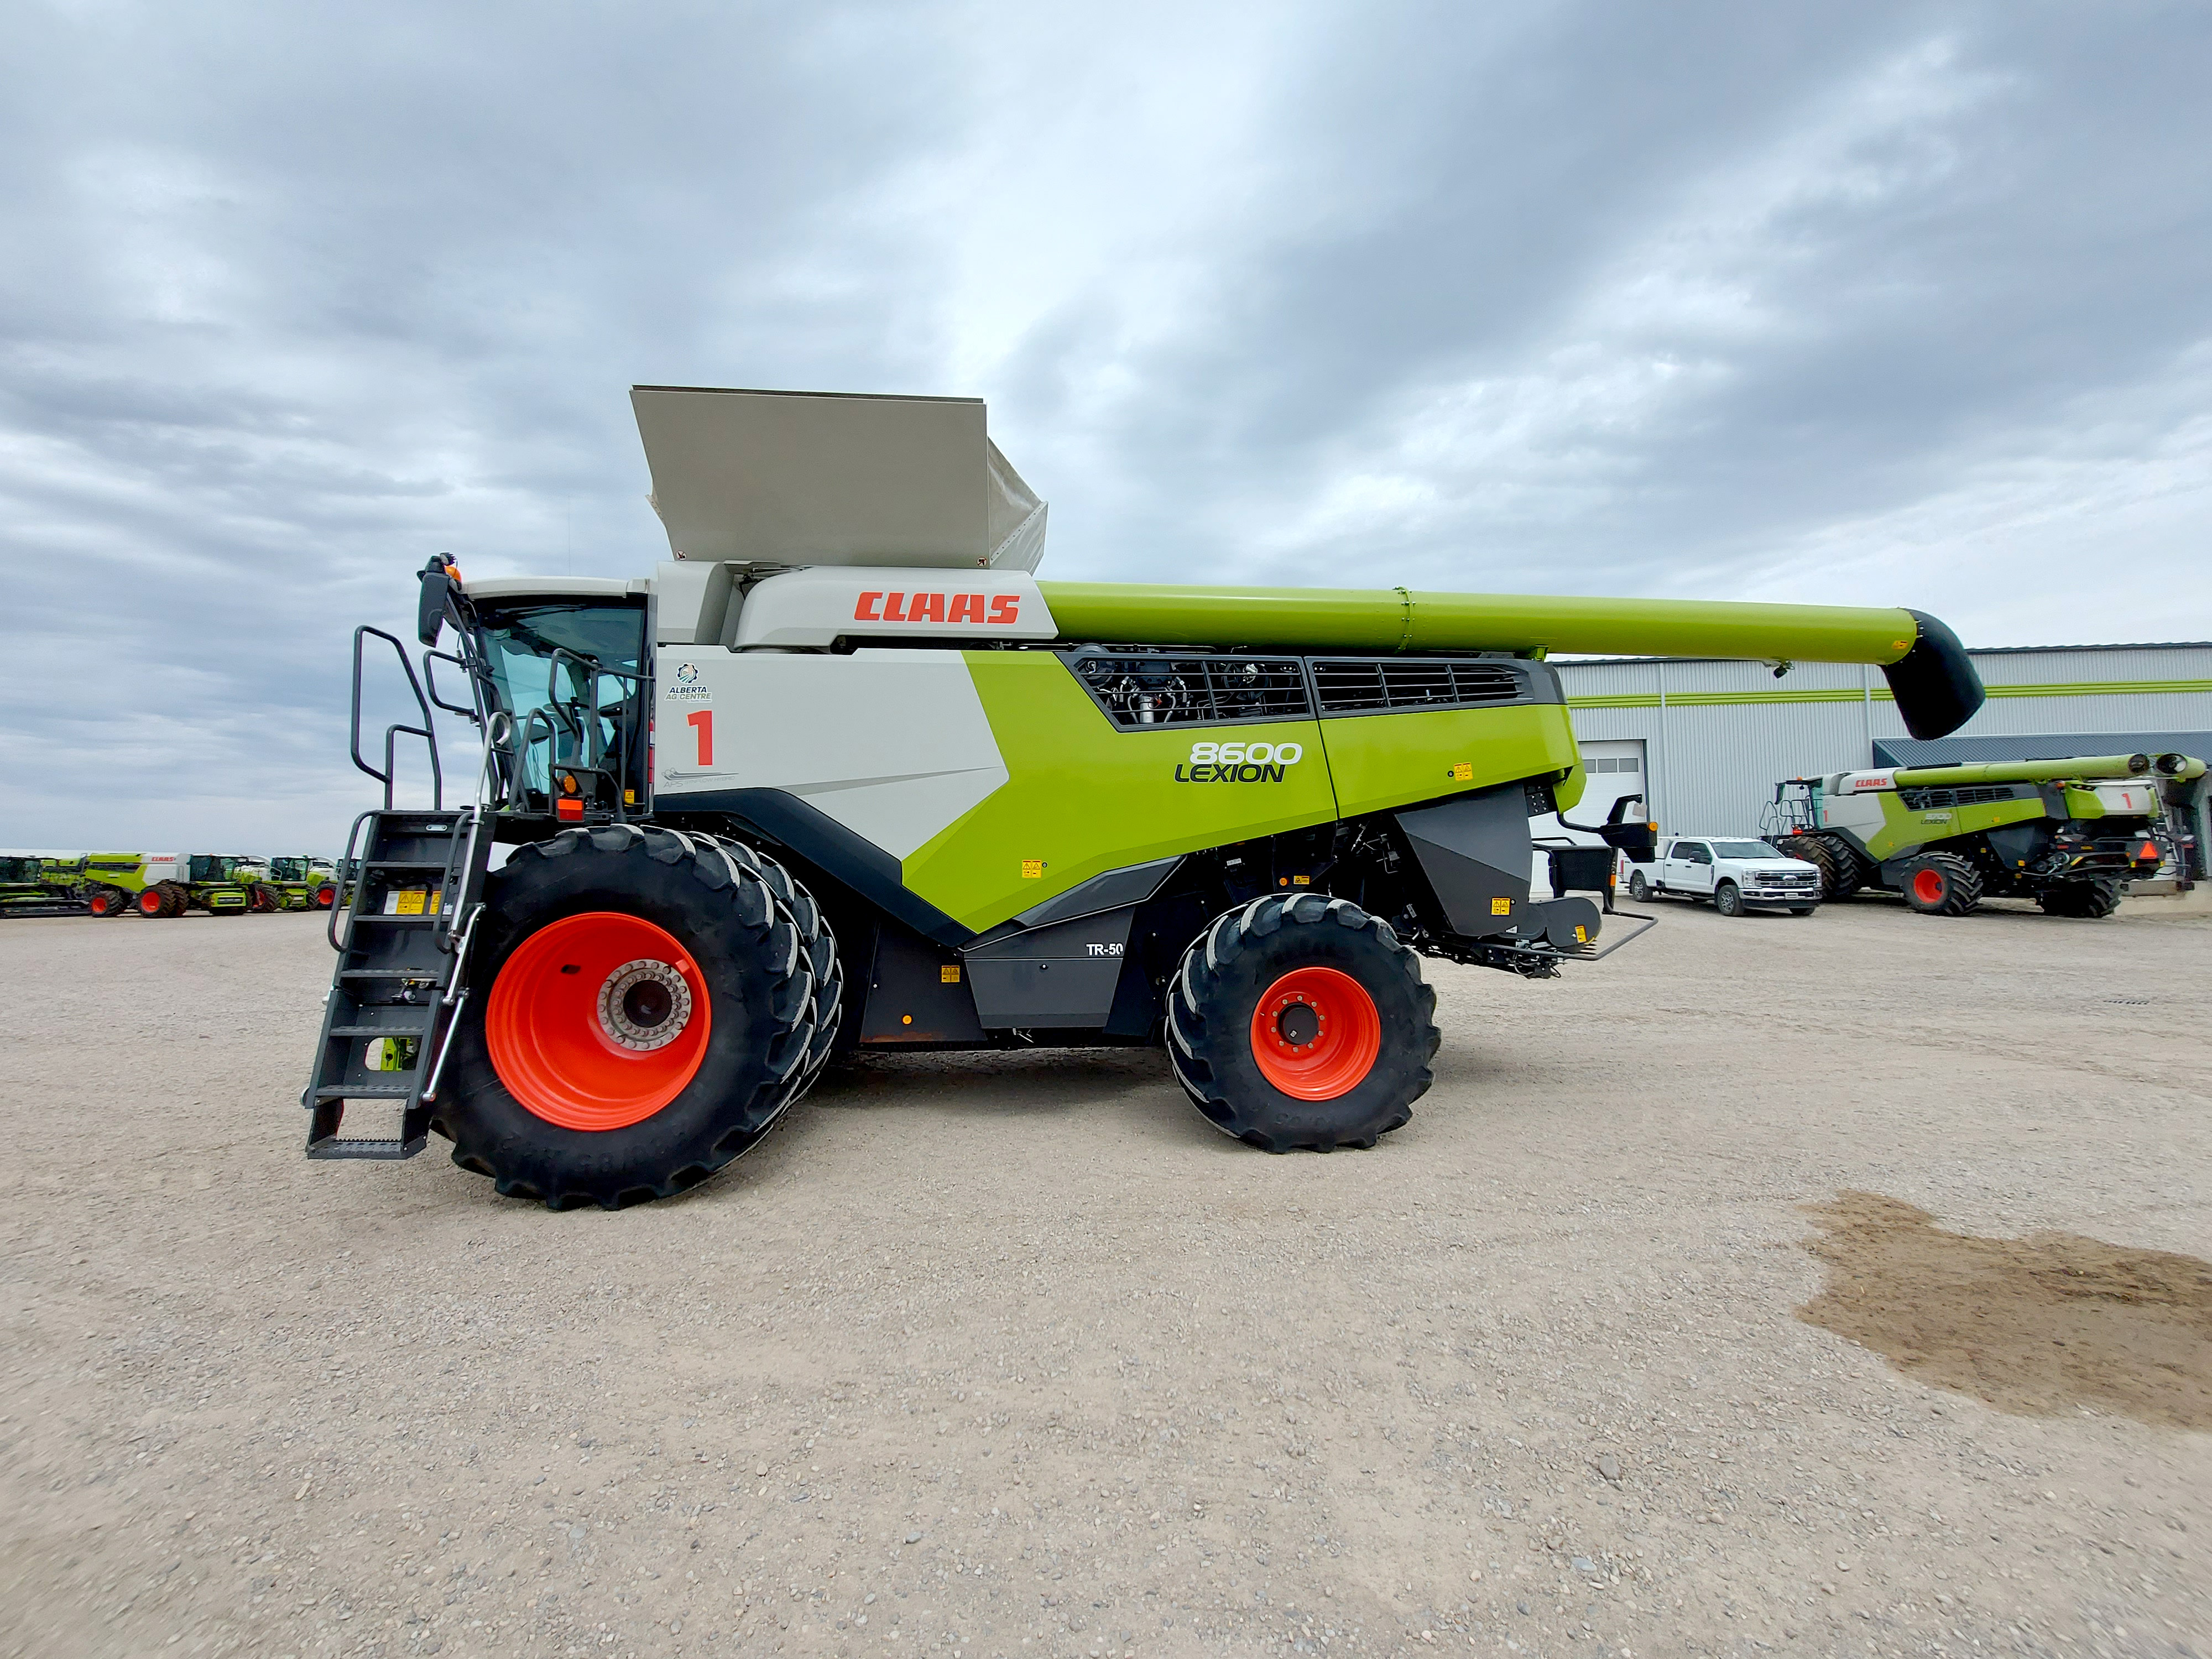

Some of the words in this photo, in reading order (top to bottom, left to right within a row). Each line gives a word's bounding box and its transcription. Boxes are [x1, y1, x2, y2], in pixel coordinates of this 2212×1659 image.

[854, 592, 1021, 624] CLAAS
[687, 710, 713, 766] 1
[1190, 742, 1303, 765] 8600
[1175, 764, 1292, 782] LEXION
[1855, 778, 1887, 787] CLAAS
[2121, 793, 2132, 809] 1
[1823, 810, 1828, 822] 1
